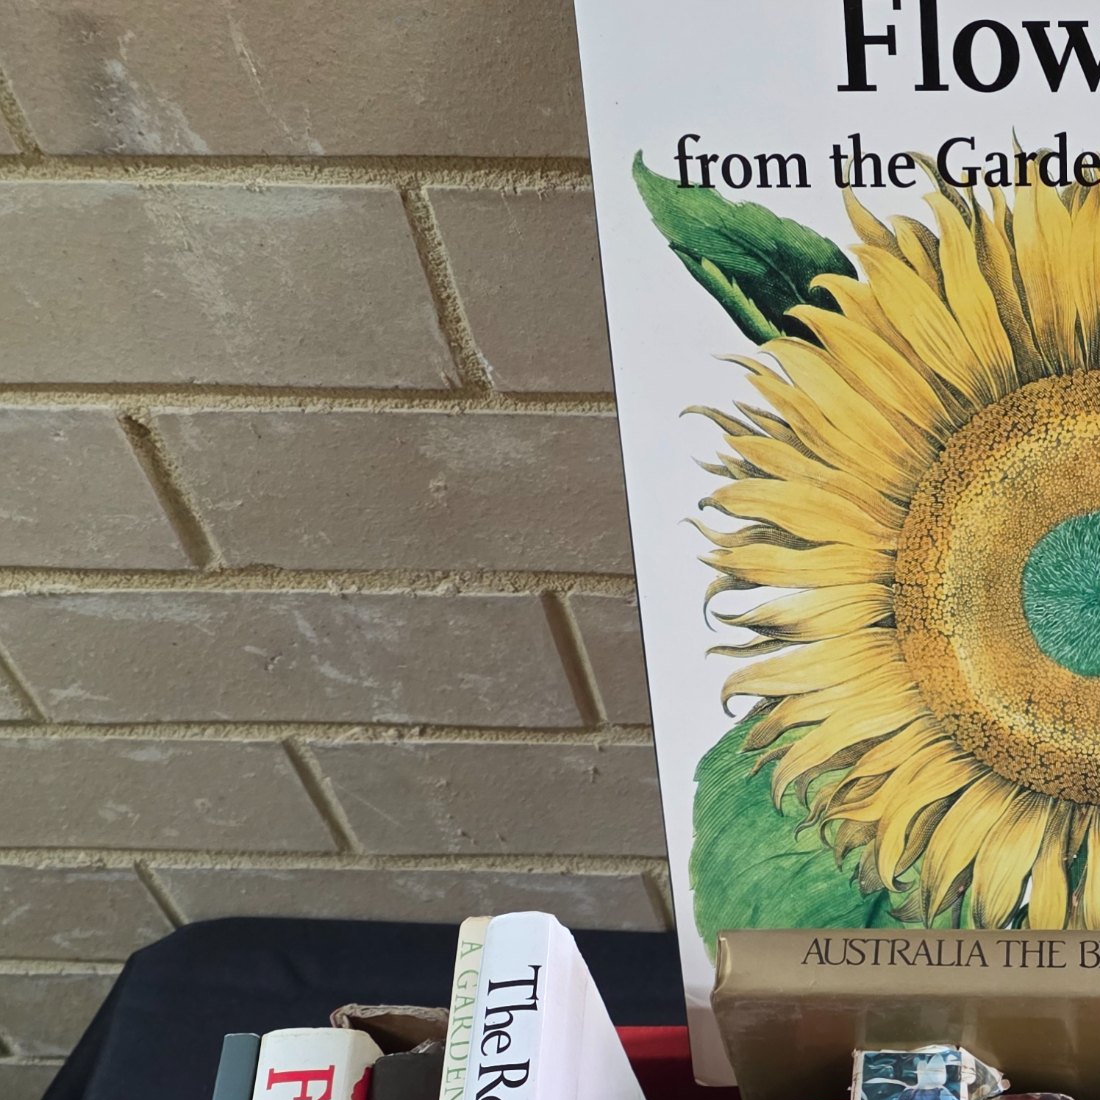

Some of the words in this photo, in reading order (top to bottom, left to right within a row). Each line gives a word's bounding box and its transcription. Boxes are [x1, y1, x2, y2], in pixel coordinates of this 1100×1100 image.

[674, 135, 812, 190] from
[829, 135, 916, 190] the
[801, 937, 989, 967] AUSTRALIA
[996, 939, 1067, 969] THE
[479, 964, 542, 1057] The
